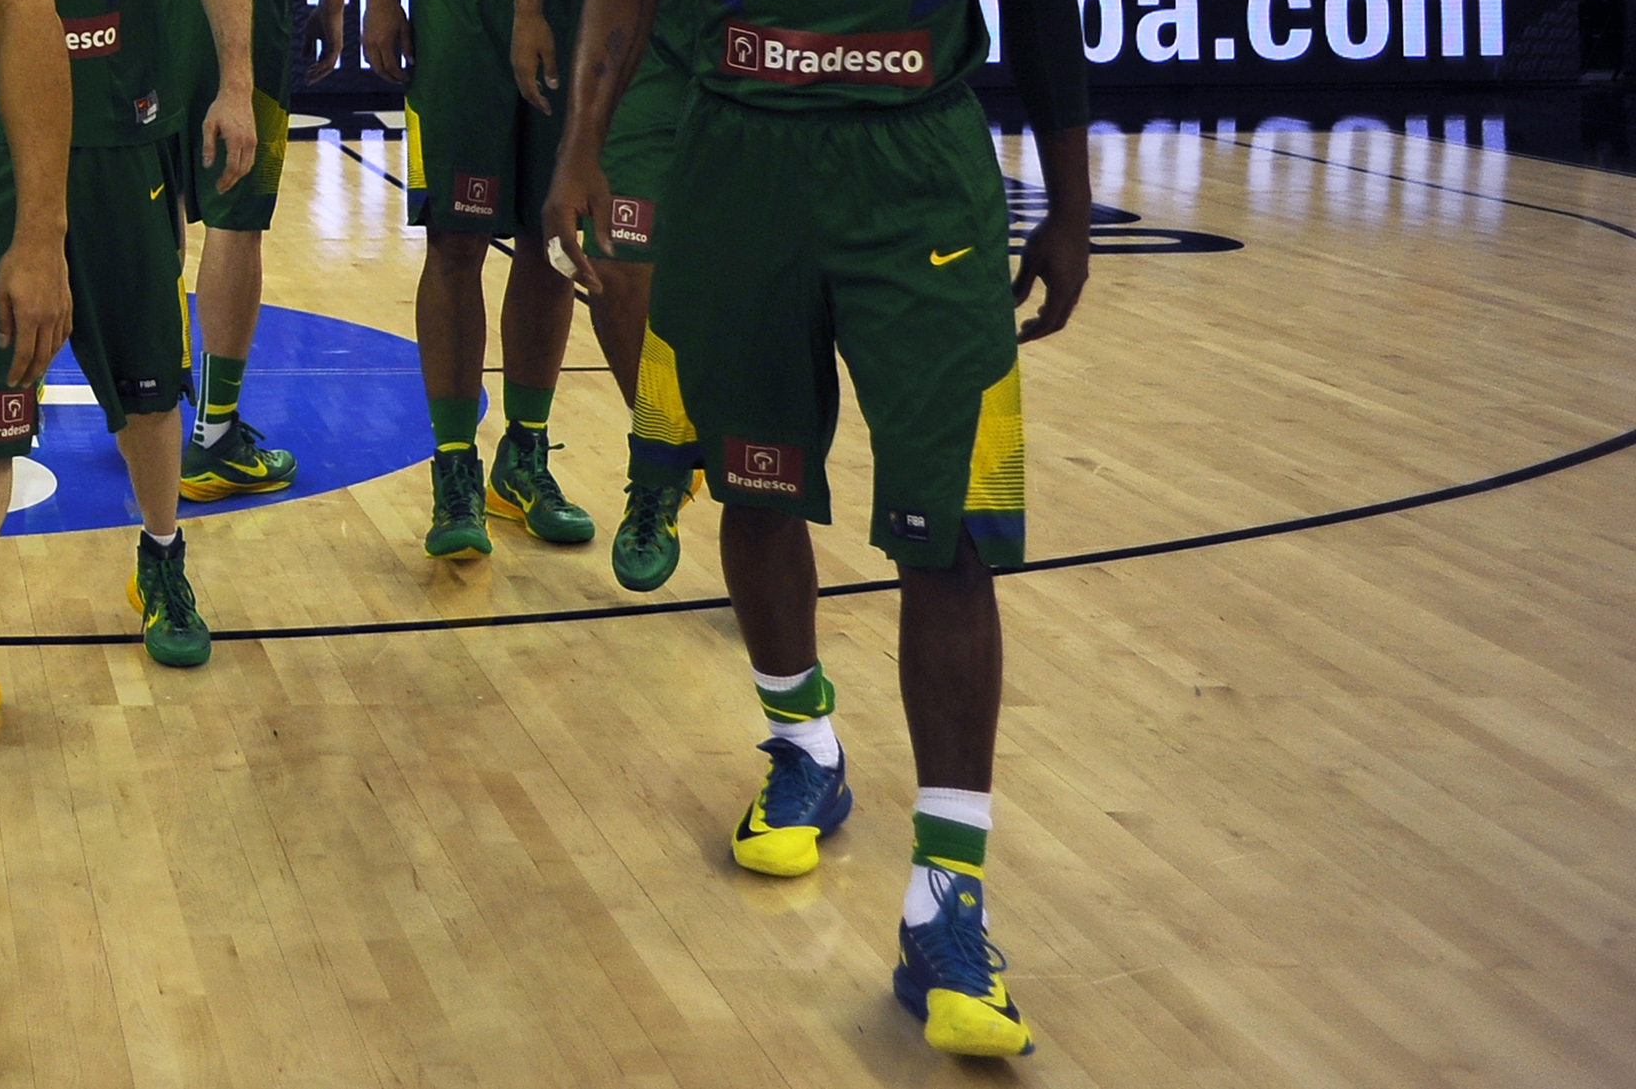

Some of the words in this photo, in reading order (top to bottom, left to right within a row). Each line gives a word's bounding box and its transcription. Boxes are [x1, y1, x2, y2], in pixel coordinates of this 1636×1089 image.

[764, 39, 924, 75] Bradesco
[454, 201, 494, 216] Bradesco
[727, 471, 798, 494] Bradesco
